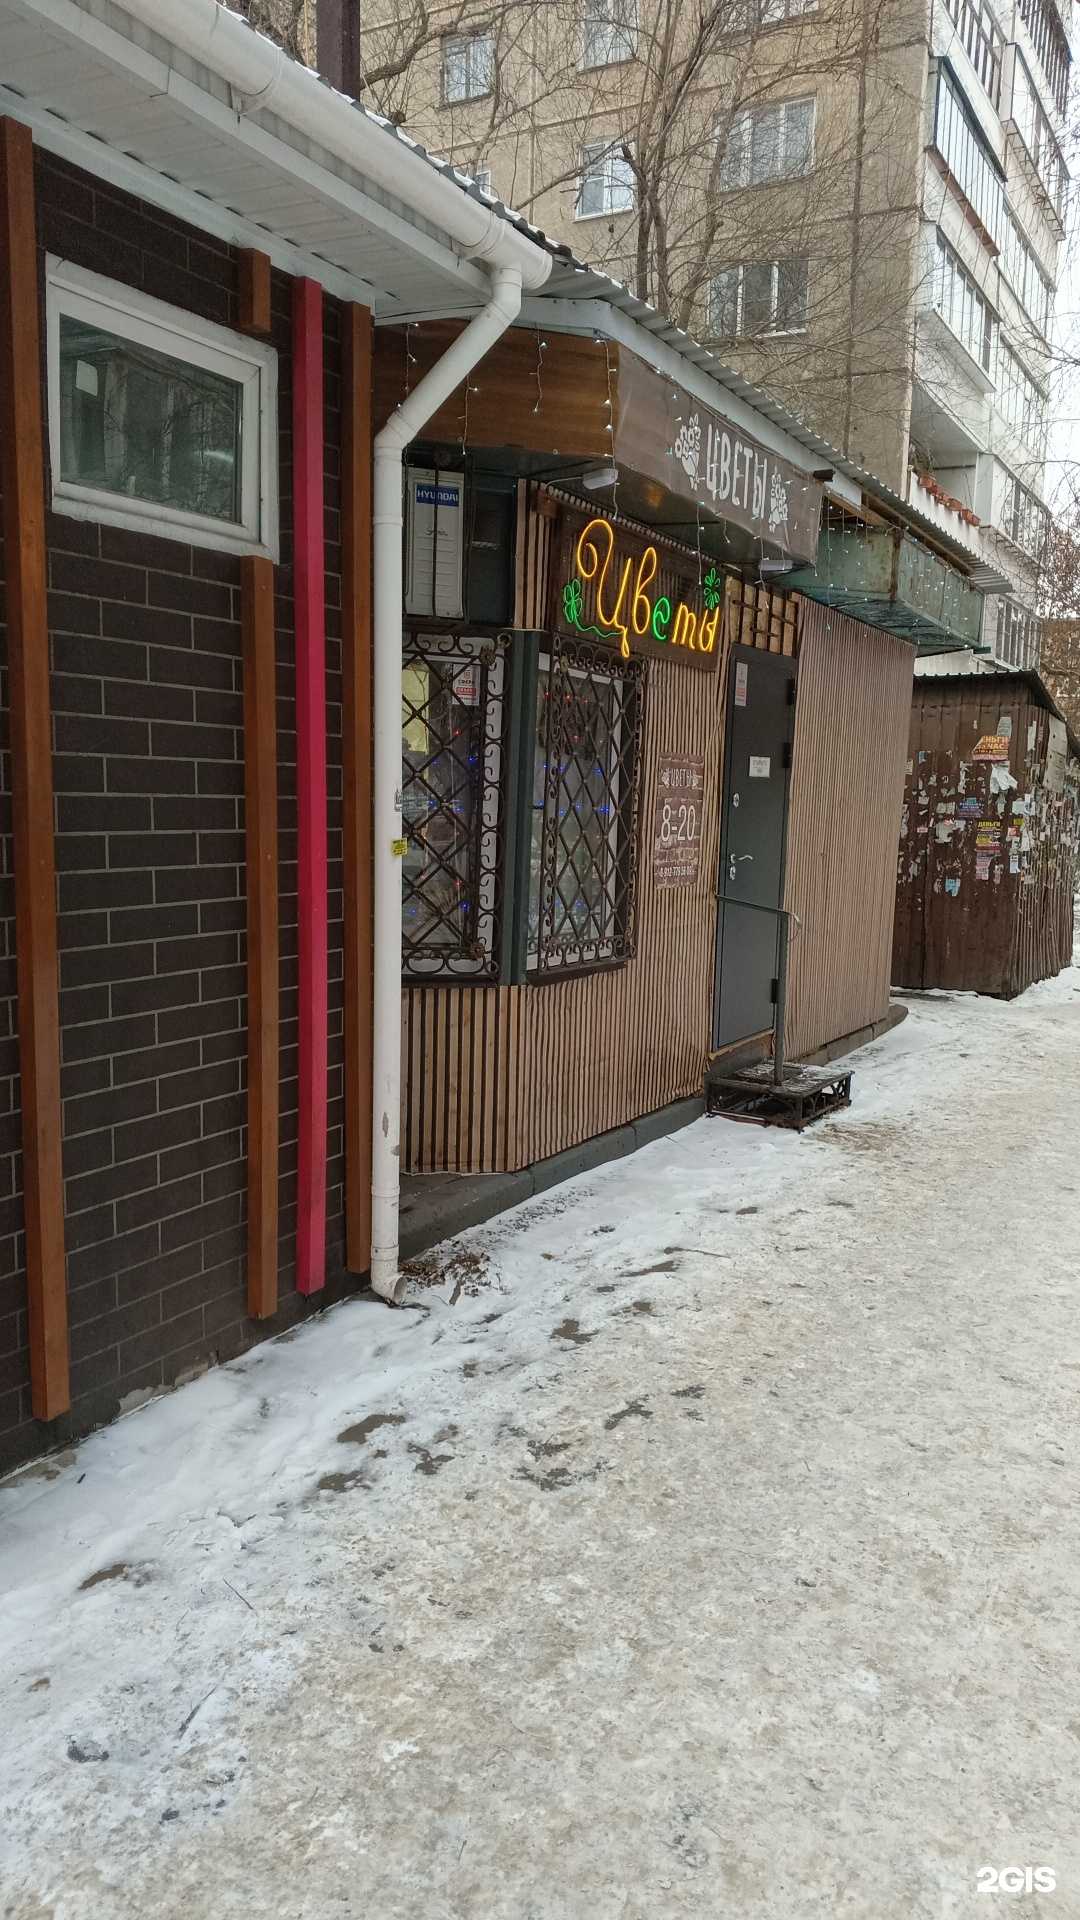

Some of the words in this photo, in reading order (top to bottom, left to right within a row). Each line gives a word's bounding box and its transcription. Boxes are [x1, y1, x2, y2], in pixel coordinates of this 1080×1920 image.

[417, 489, 459, 503] HYUNDAI
[706, 423, 767, 519] ЦВЕТЫ
[577, 519, 719, 658] Цветы
[661, 804, 696, 841] 8-20
